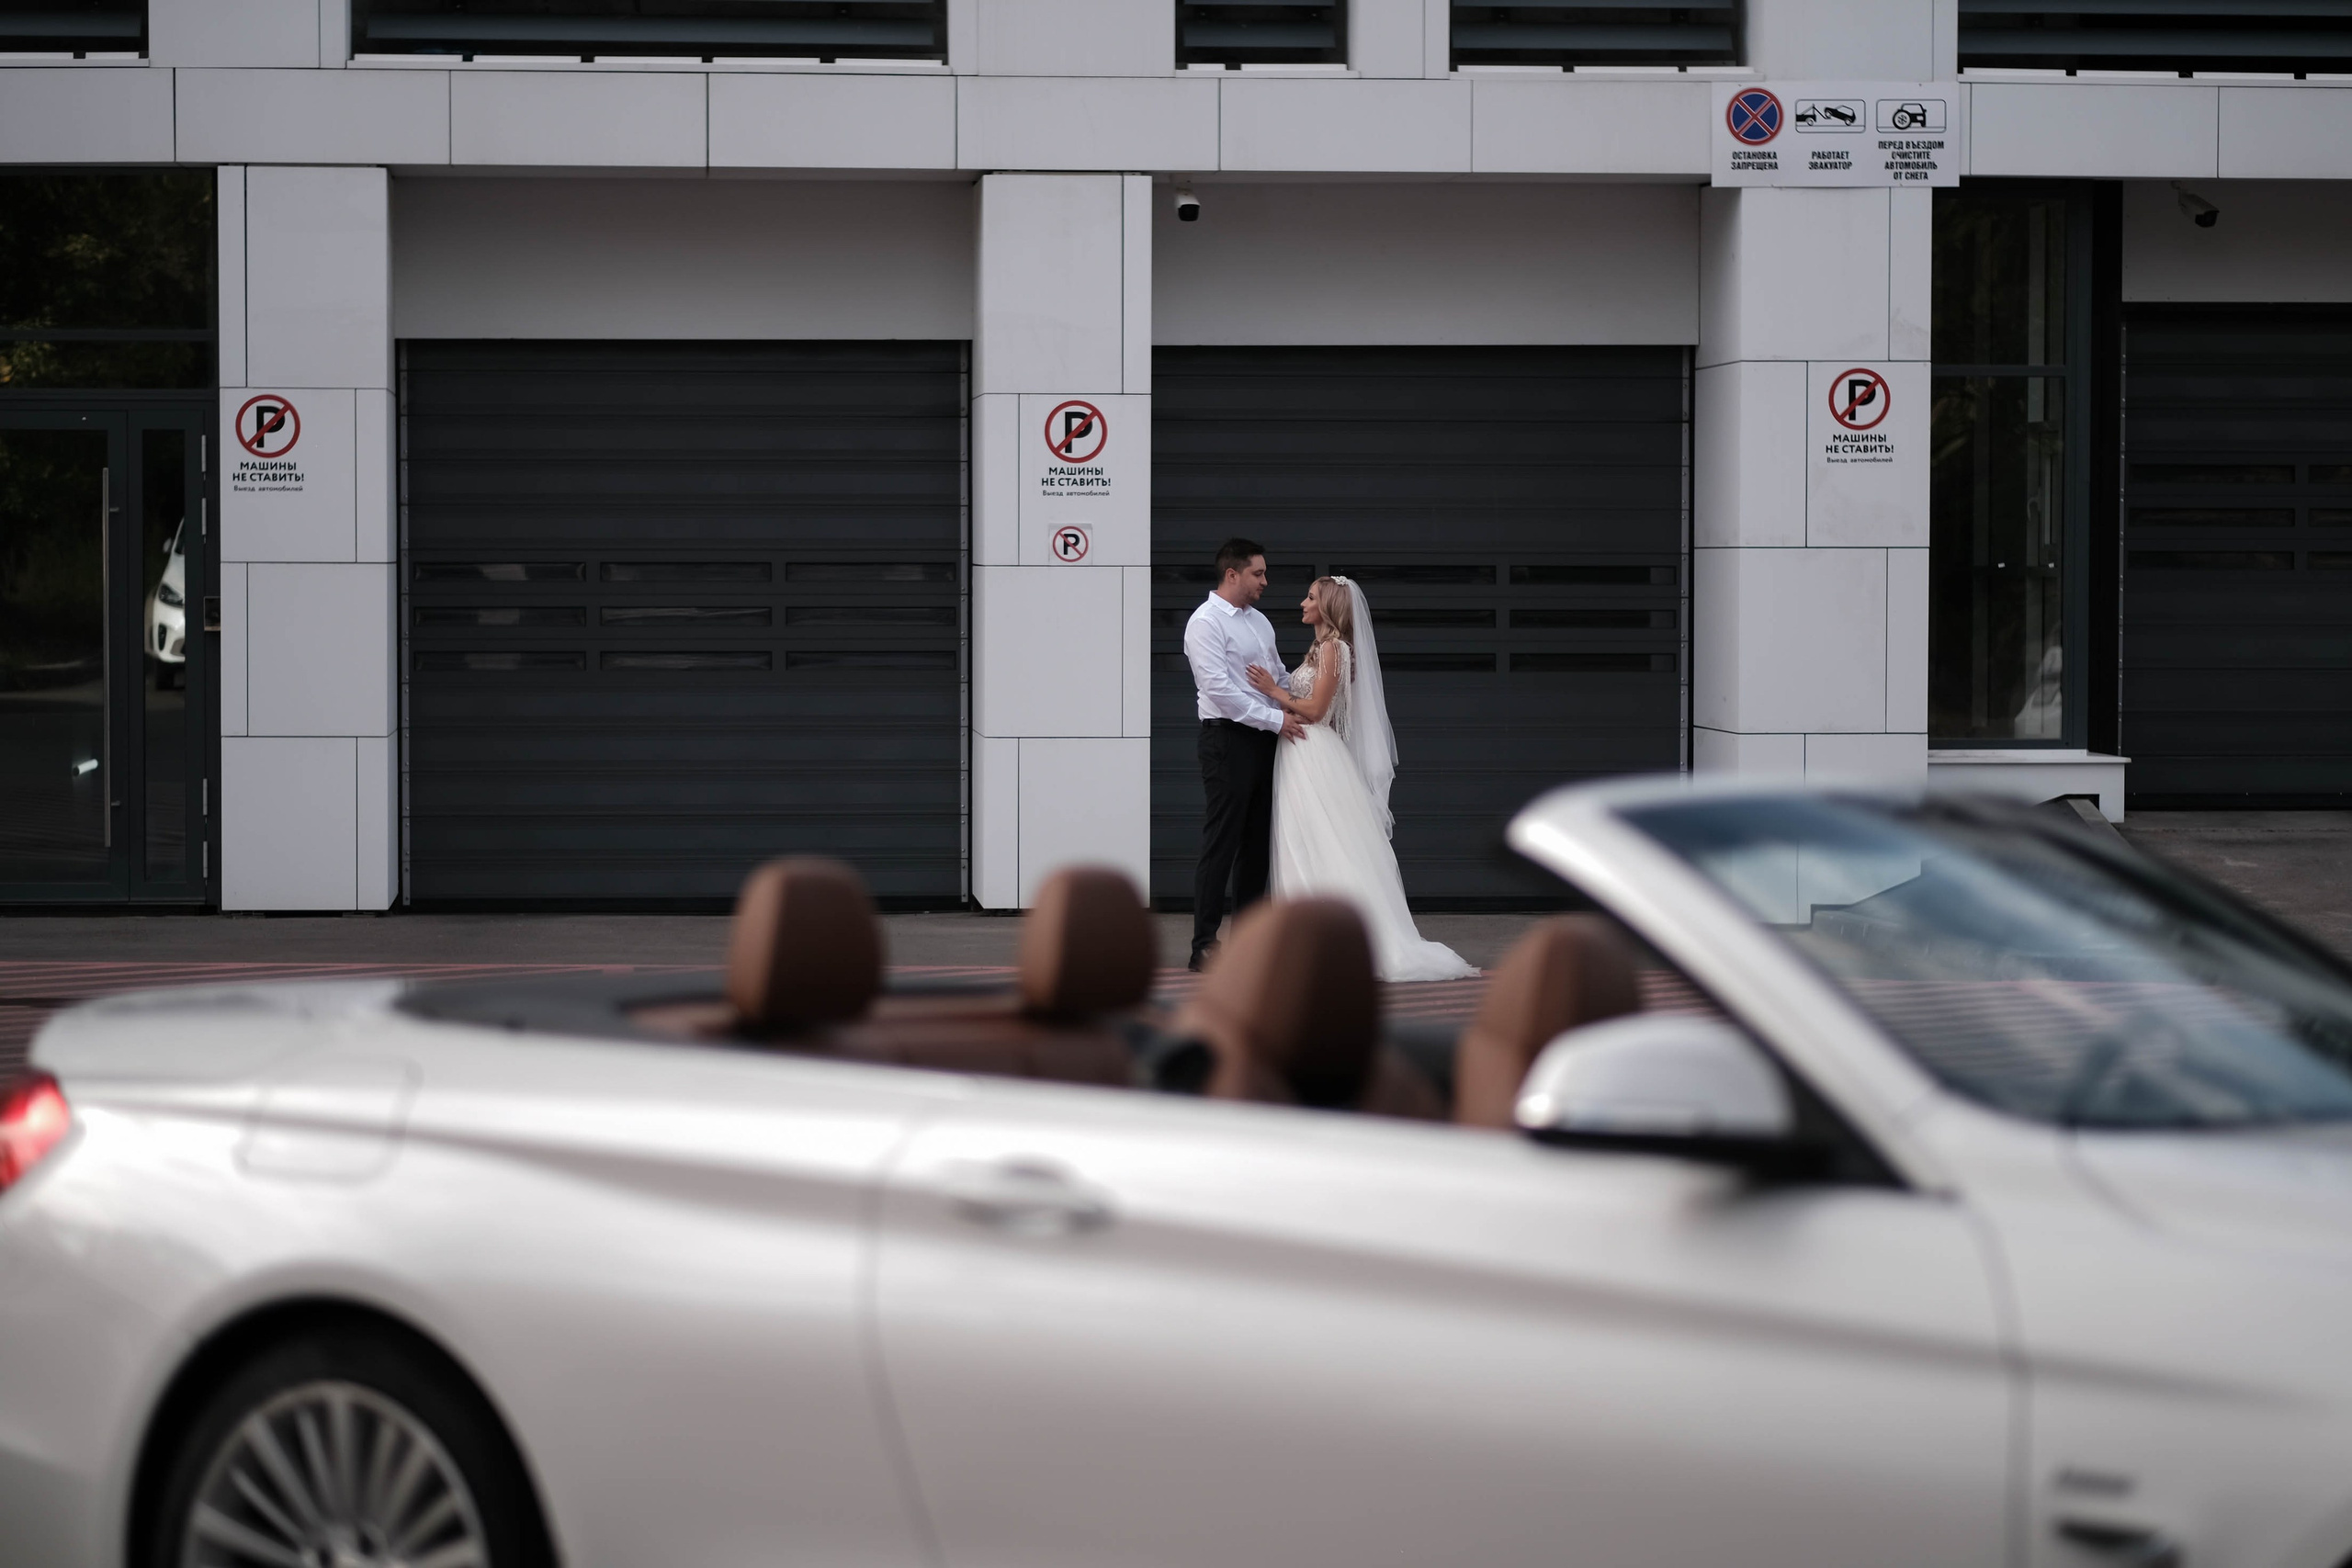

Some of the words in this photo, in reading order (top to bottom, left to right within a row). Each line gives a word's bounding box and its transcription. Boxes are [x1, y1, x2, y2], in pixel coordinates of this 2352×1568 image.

[1878, 141, 1904, 151] ПЕРЕД
[1905, 141, 1944, 151] ВЪЕЗДОМ
[1732, 151, 1778, 160] ОСТАНОВКА
[1811, 151, 1849, 160] РАБОТАЕТ
[1891, 151, 1931, 160] ОЧИСТИТЕ
[1731, 161, 1779, 171] ЗАПРЕЩЕНА
[1808, 161, 1853, 170] ЭВАКУАТОР
[1884, 161, 1938, 170] АВТОМОБИЛЬ
[1893, 171, 1904, 180] ОТ
[1905, 171, 1928, 180] СНЕГА
[1832, 434, 1886, 443] МАШИНЫ
[1826, 445, 1839, 454] НЕ
[1841, 445, 1894, 454] СТАВИТЬ!
[240, 461, 297, 471] МАШИНЫ
[1048, 467, 1103, 476] МАШИНЫ
[232, 472, 247, 482] НЕ
[249, 472, 304, 482] СТАВИТЬ!
[1041, 478, 1056, 487] НЕ
[1057, 478, 1111, 487] СТАВИТЬ!
